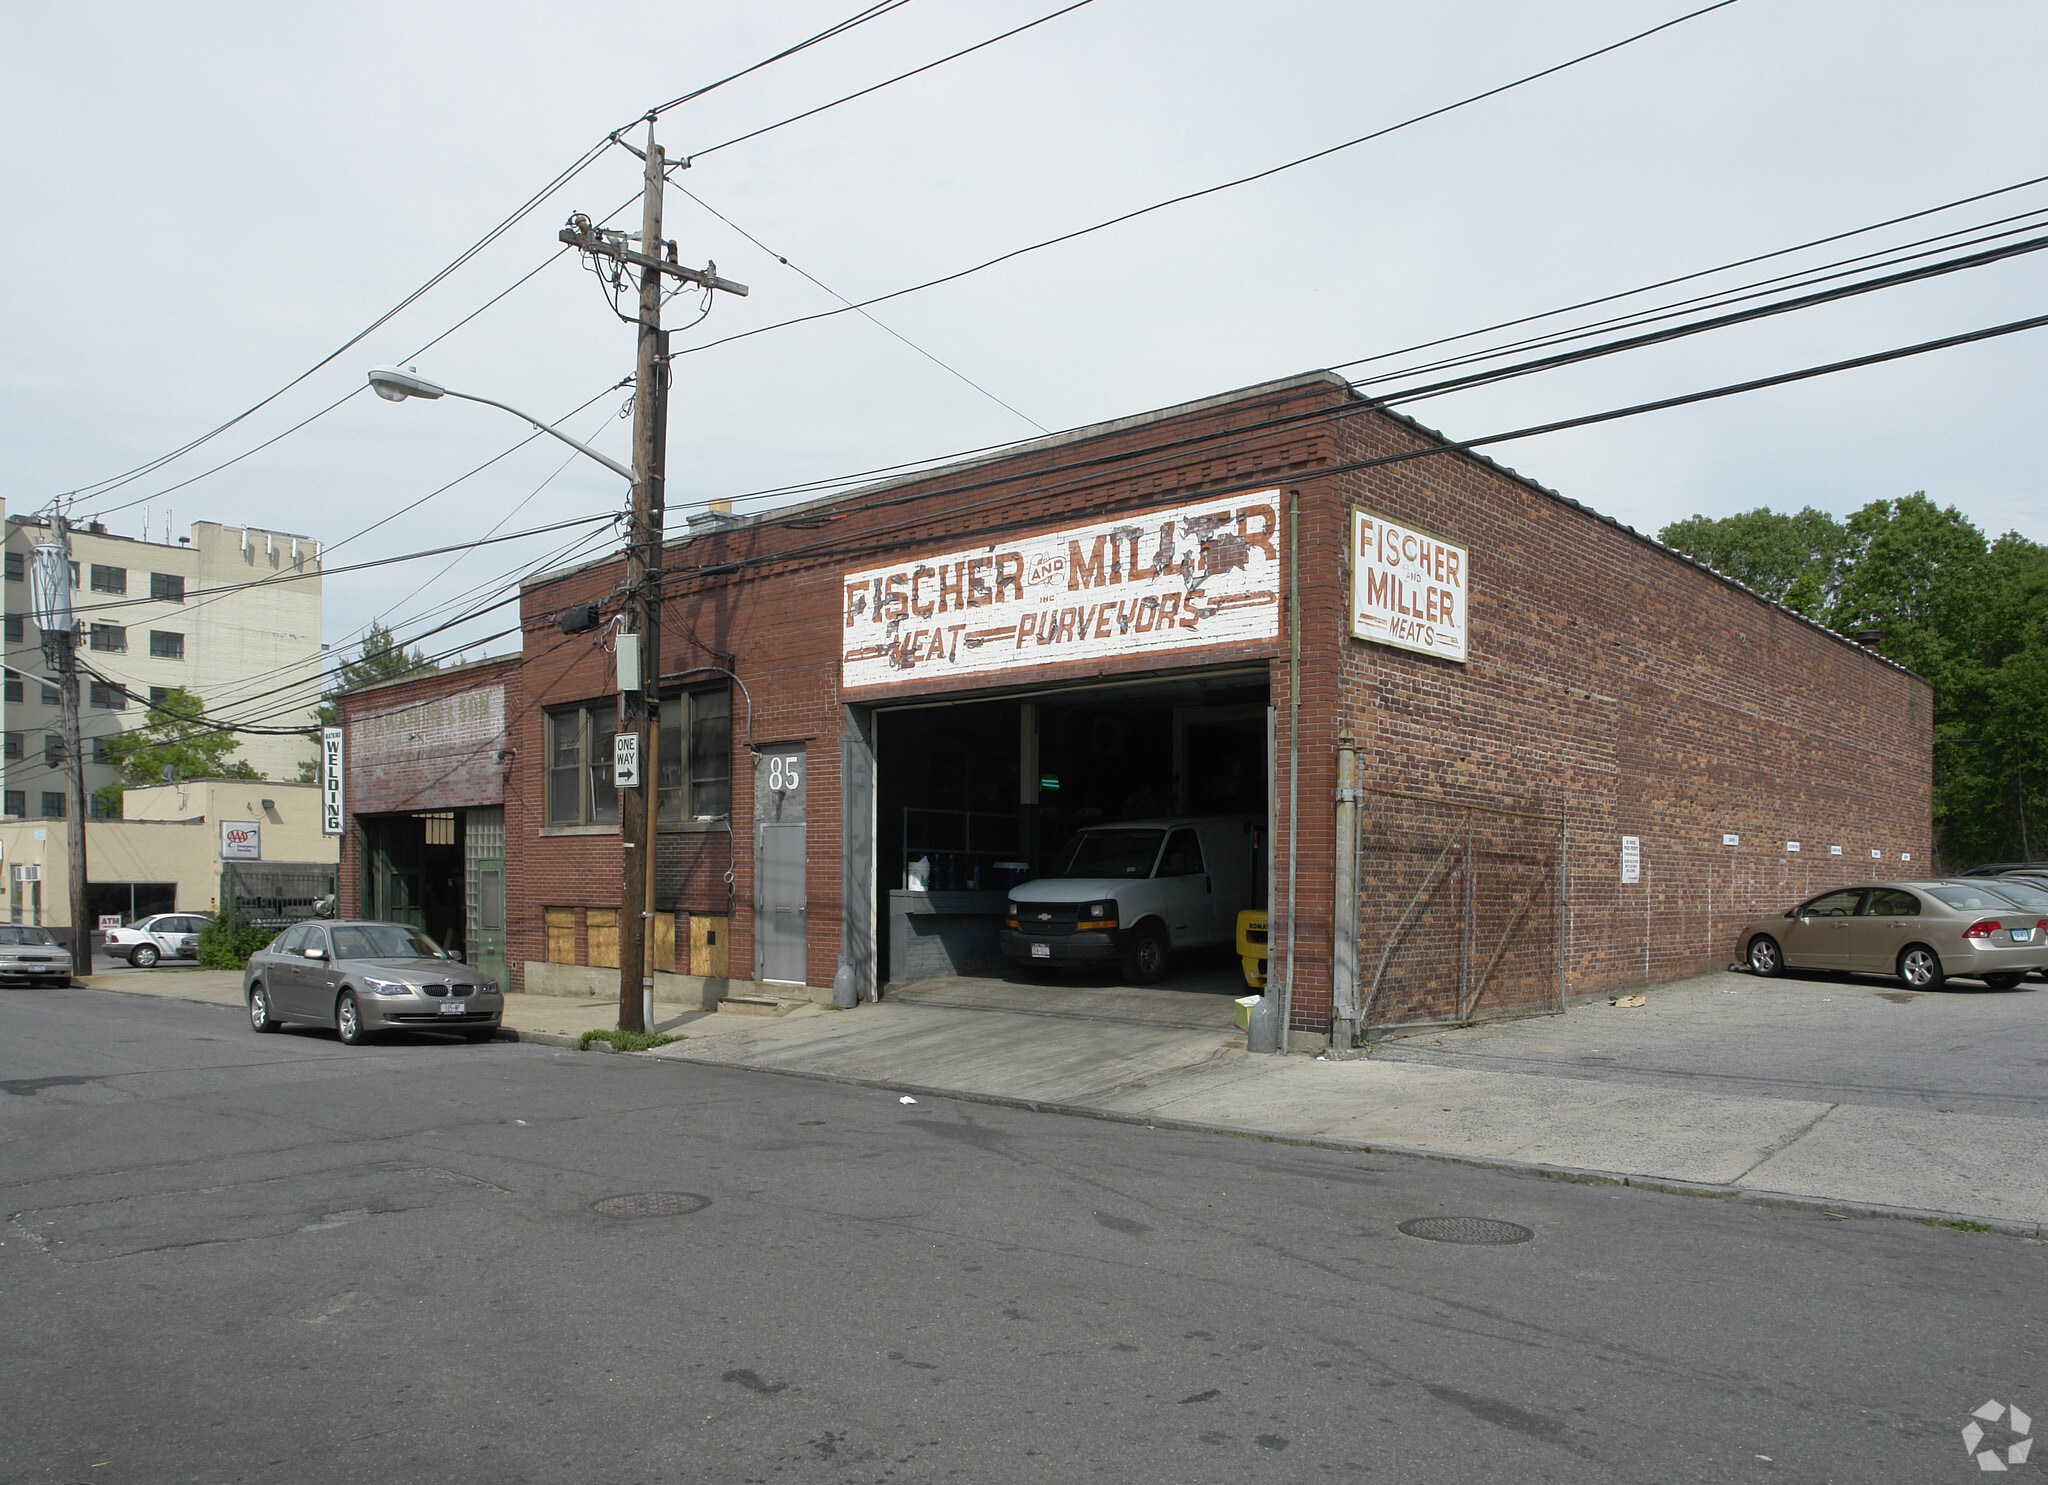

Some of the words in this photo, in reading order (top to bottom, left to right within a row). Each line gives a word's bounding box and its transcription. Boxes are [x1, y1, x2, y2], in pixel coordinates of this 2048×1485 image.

[1360, 518, 1460, 588] FISCHER
[846, 551, 1024, 628] FISCHER
[1031, 559, 1063, 582] AND
[1406, 572, 1422, 583] AND
[1039, 595, 1055, 604] INC
[1367, 566, 1454, 628] MILLER
[1016, 589, 1205, 649] PURVEYORS
[1389, 616, 1434, 646] MEATS
[459, 693, 490, 722] SON
[617, 738, 635, 751] ONE
[617, 752, 635, 765] WAY
[326, 741, 340, 829] WELDING
[769, 756, 799, 790] 85
[228, 830, 247, 842] AAA
[101, 917, 120, 925] ATM
